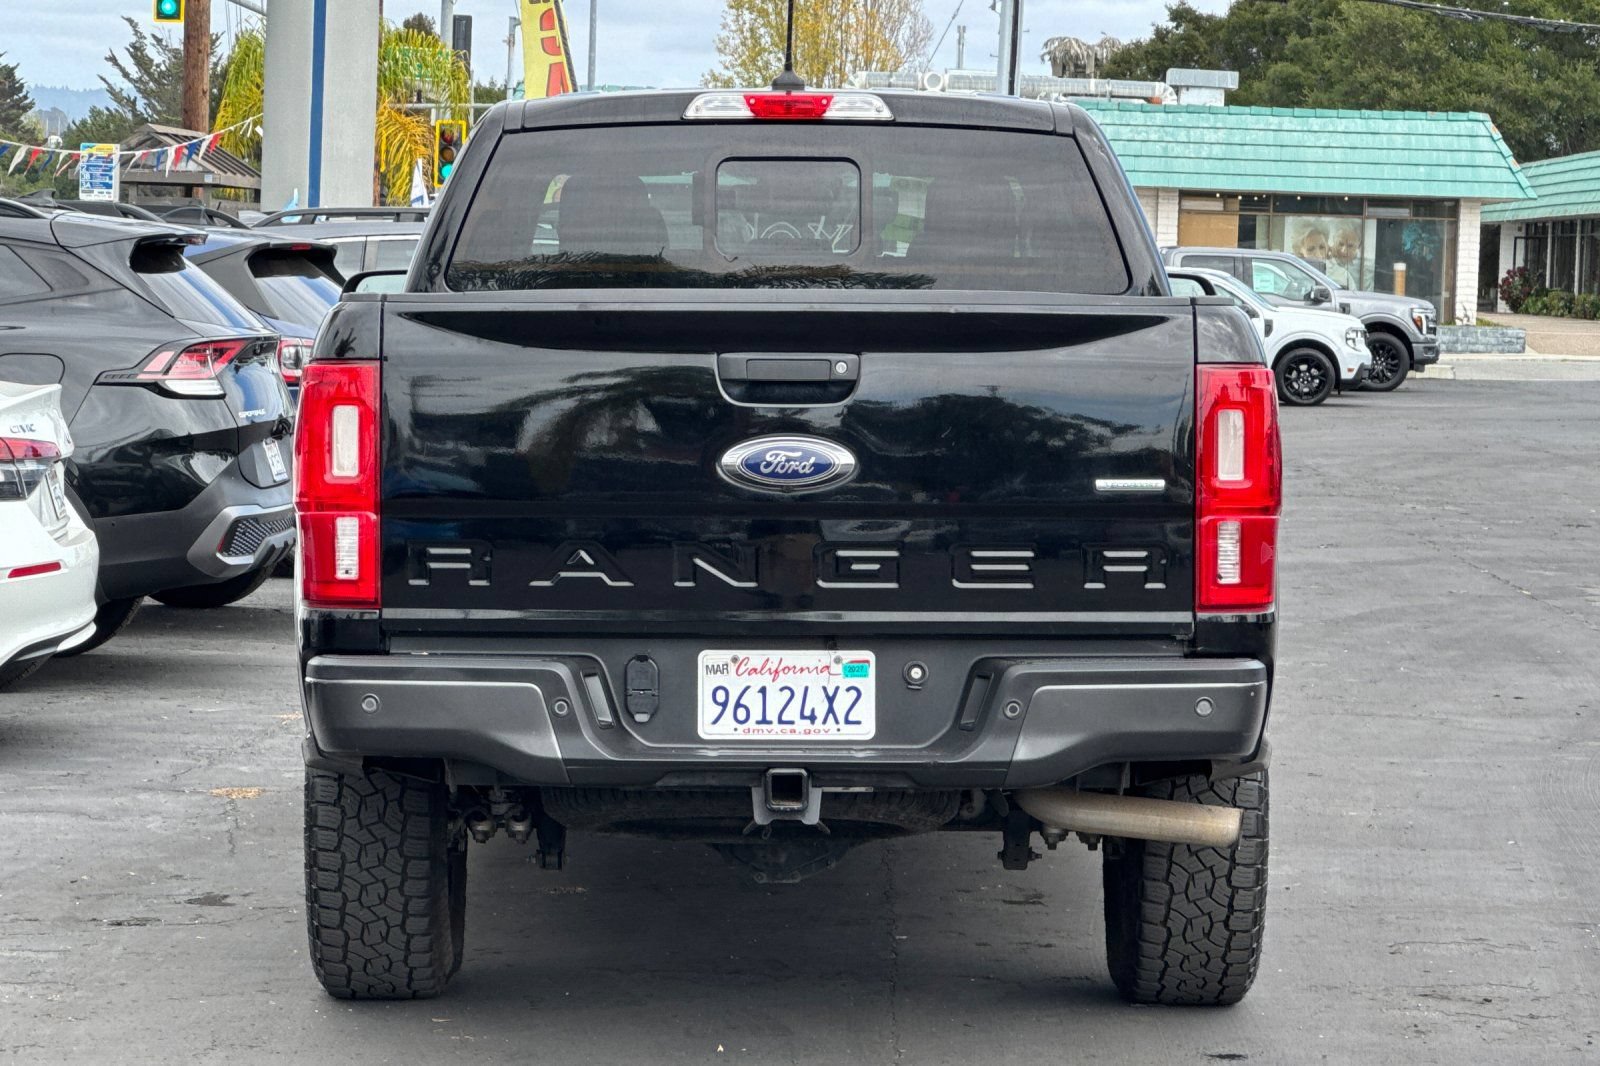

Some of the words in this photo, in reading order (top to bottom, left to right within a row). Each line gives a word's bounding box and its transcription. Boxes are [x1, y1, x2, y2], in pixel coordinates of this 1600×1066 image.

[760, 450, 816, 474] Ford
[407, 541, 1171, 588] RANGER
[705, 663, 729, 676] MAR
[735, 656, 841, 682] California
[847, 665, 865, 673] 2027
[711, 685, 862, 725] 96124X2
[742, 726, 831, 735] dmv.ca.gov
